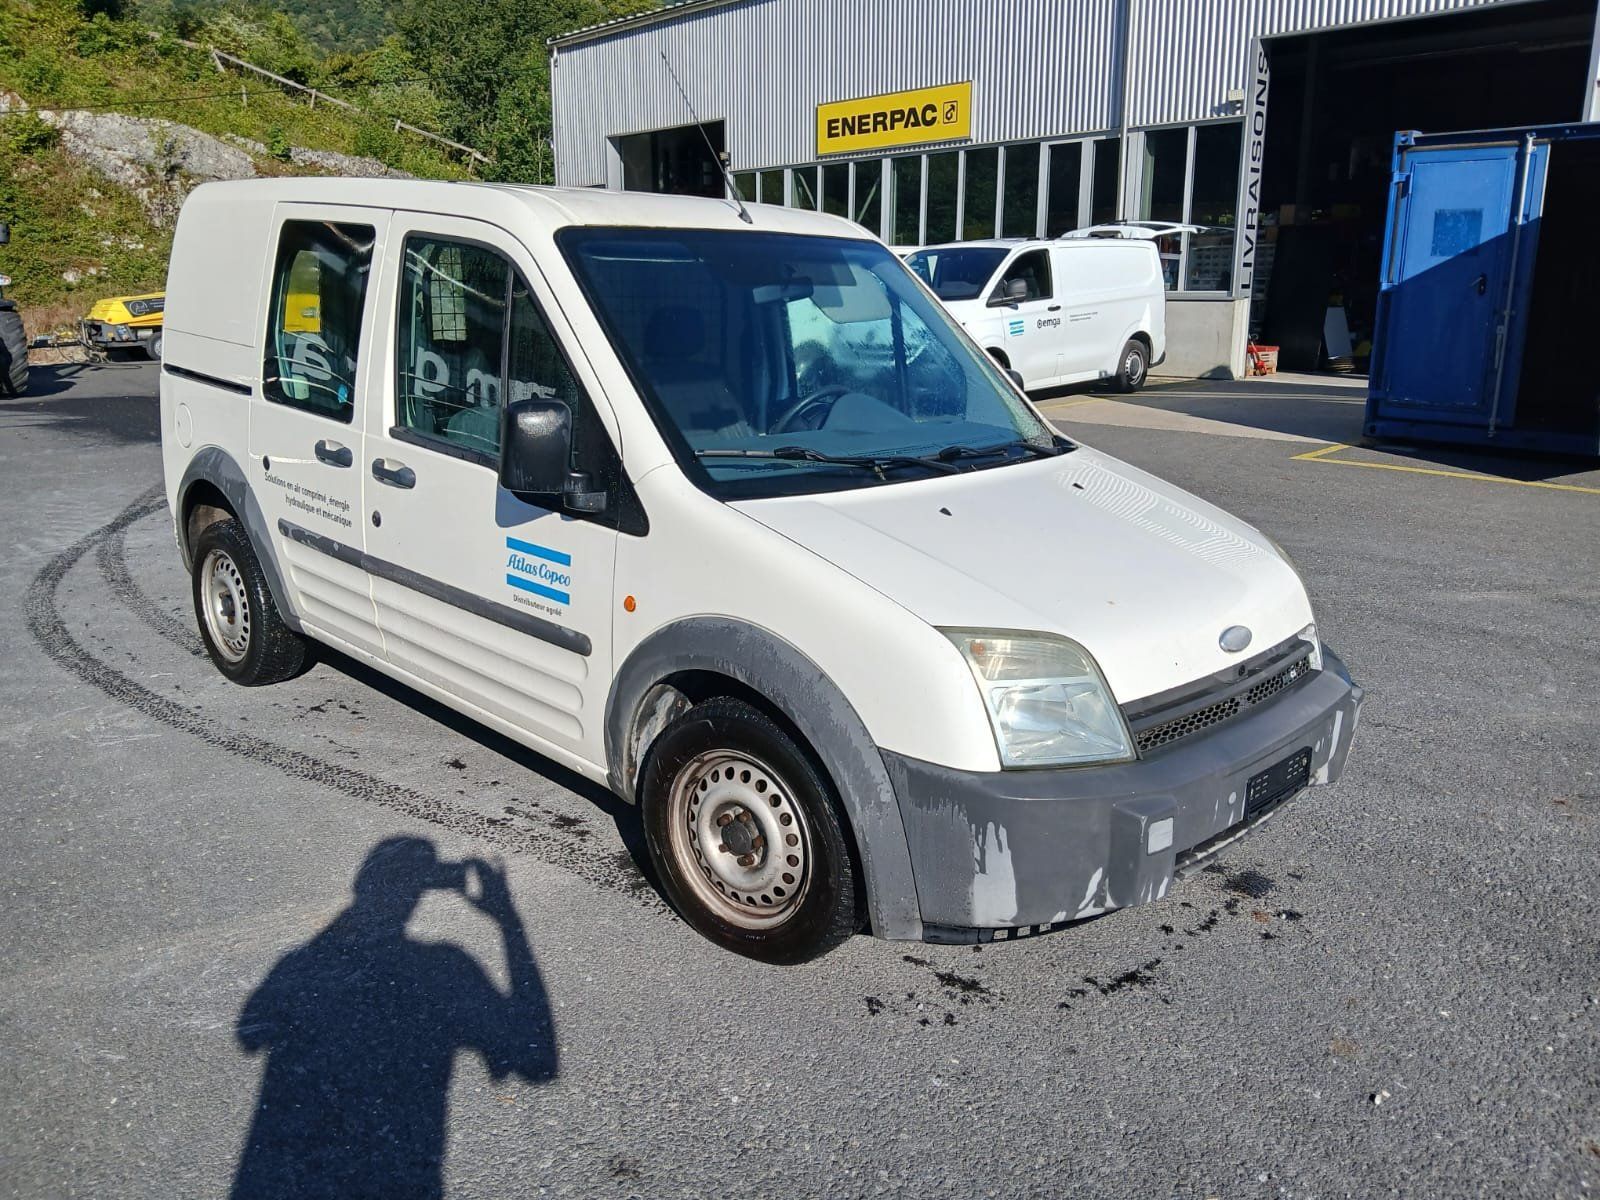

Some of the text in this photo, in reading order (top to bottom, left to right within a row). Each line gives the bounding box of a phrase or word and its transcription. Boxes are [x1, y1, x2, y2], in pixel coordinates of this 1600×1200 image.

[827, 103, 938, 139] ENERPAC
[1241, 51, 1270, 290] LIVRAISONS
[1042, 318, 1061, 329] emga
[264, 472, 286, 488] Solutions
[287, 482, 294, 491] en
[285, 494, 353, 528] hydraulique et mécanique
[506, 553, 571, 587] Atlas Copco
[513, 594, 545, 610] Distributeur
